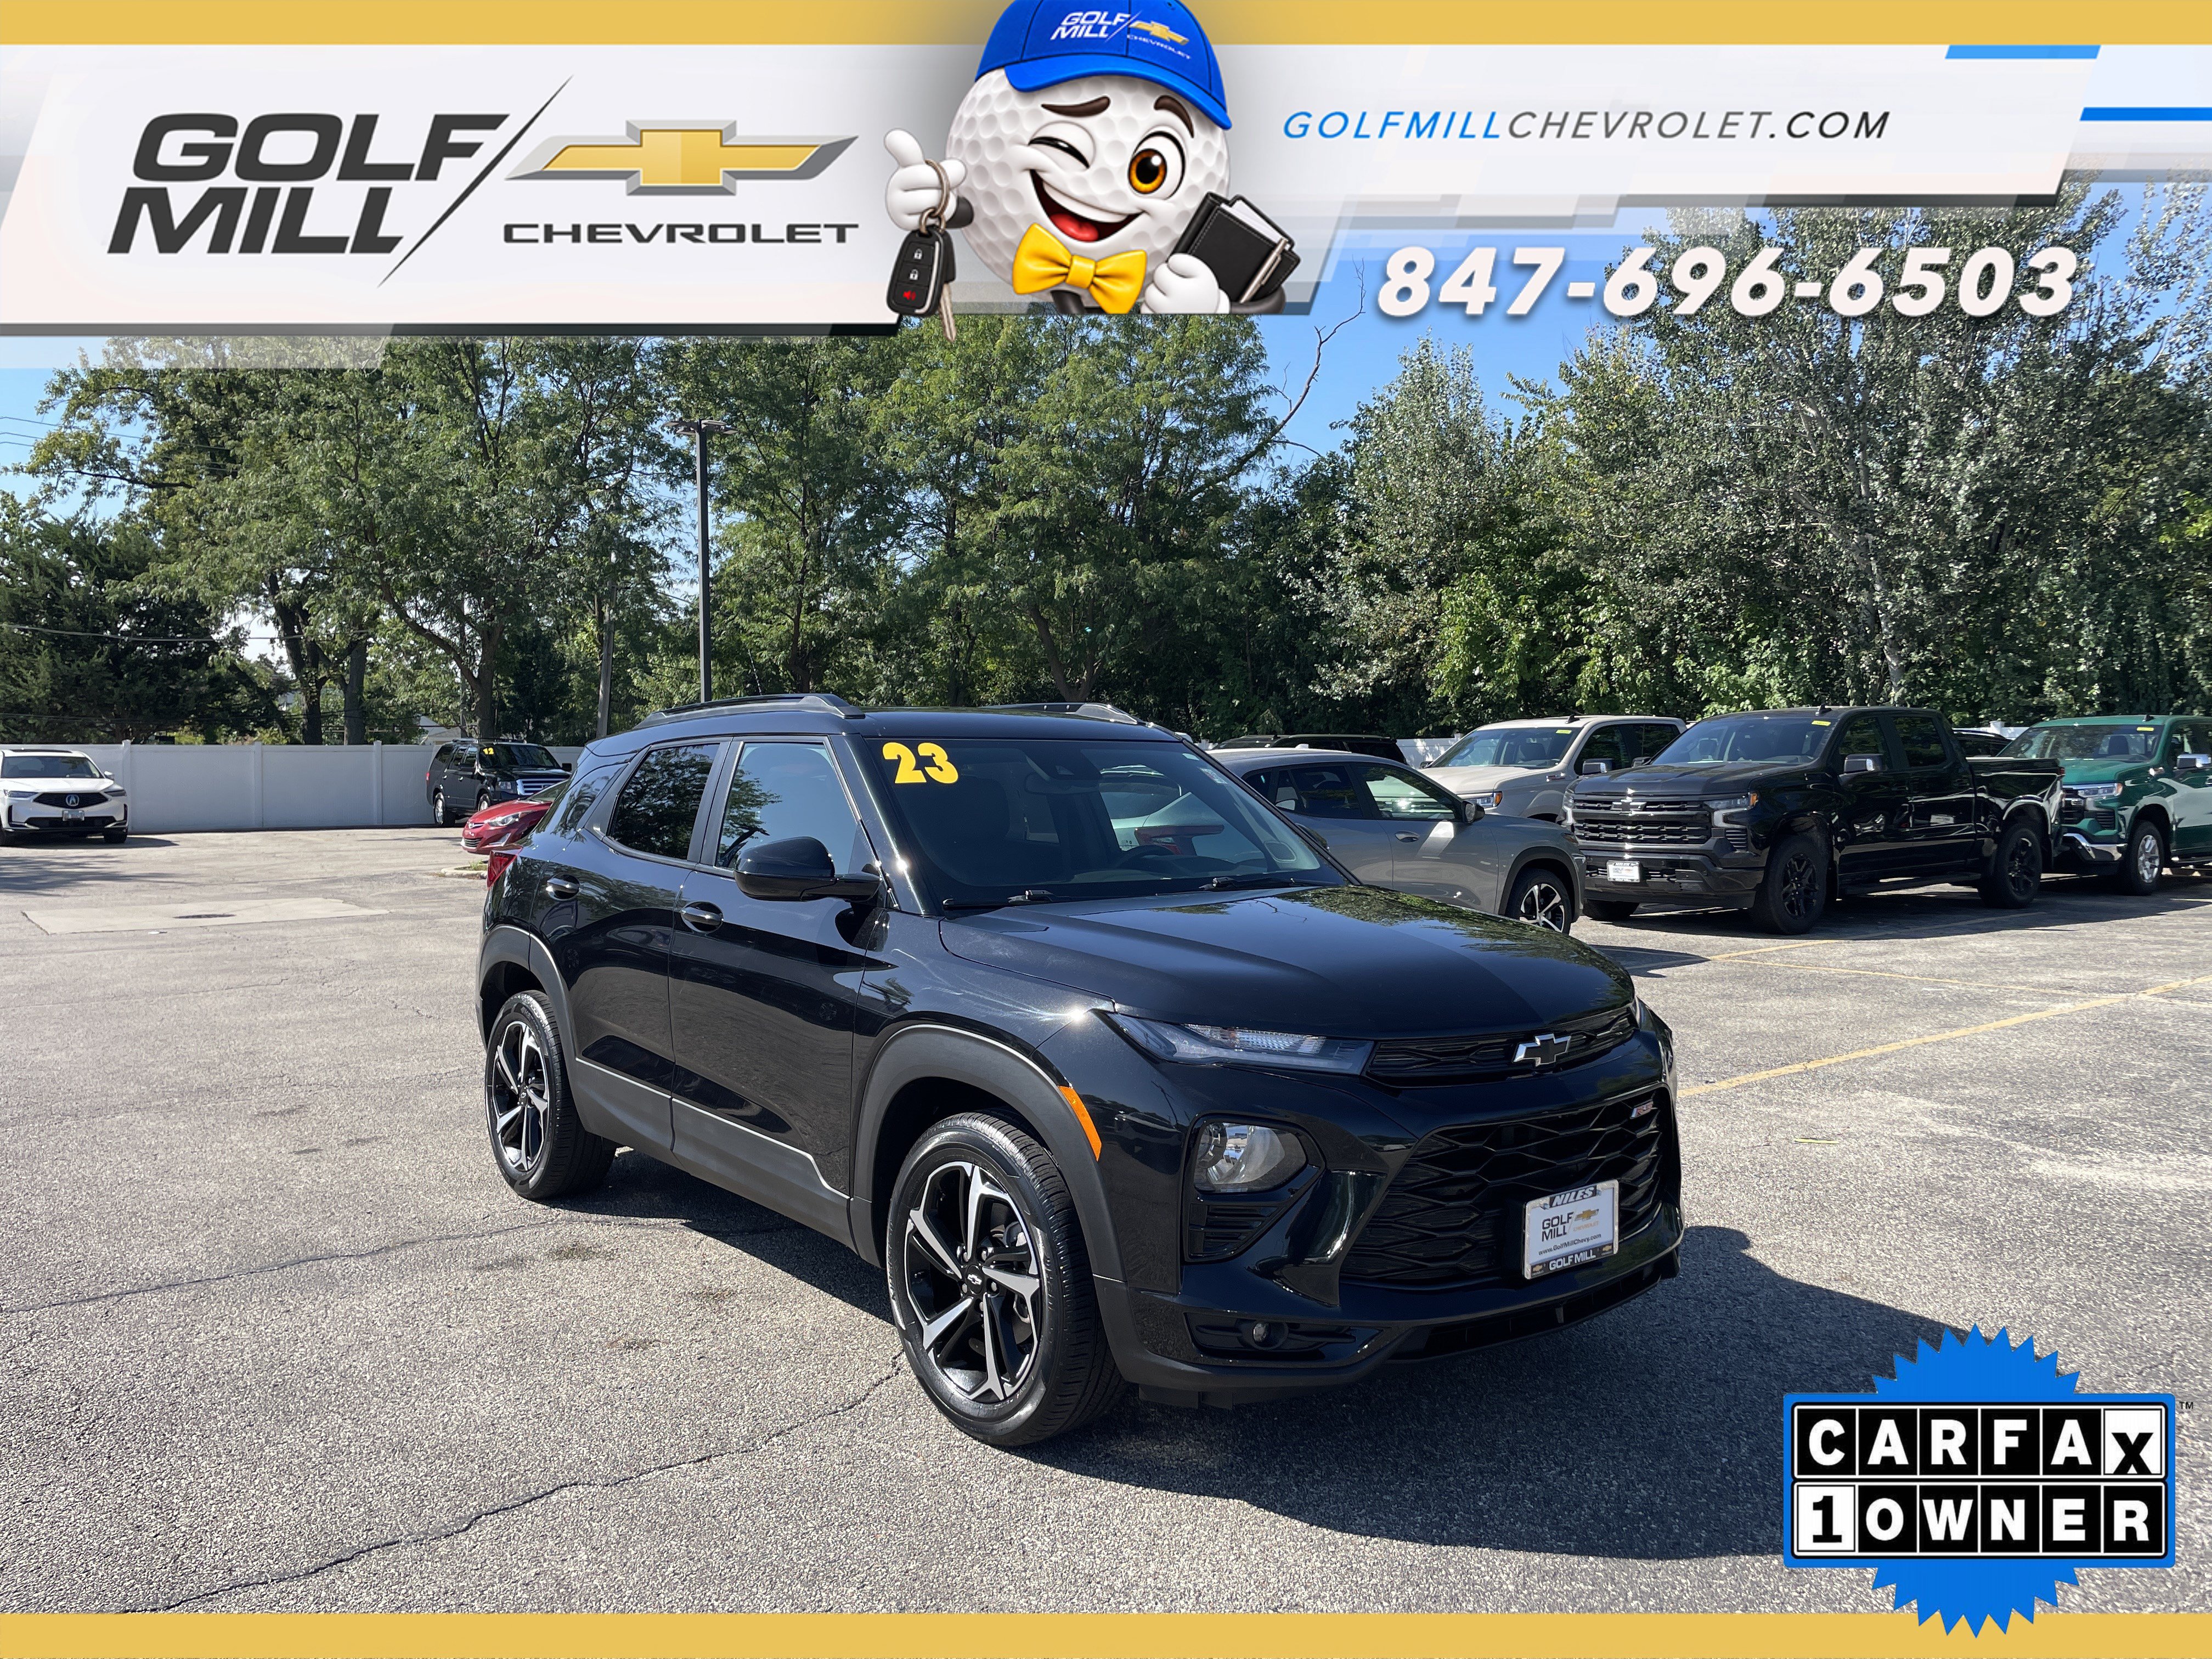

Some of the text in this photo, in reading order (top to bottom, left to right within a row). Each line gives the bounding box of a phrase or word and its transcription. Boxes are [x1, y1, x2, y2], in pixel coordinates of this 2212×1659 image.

[882, 742, 958, 784] 23
[1551, 1187, 1594, 1207] NILES
[1542, 1211, 1574, 1229] GOLF
[1542, 1225, 1567, 1242] MILL
[1549, 1250, 1596, 1271] GOLF MILL
